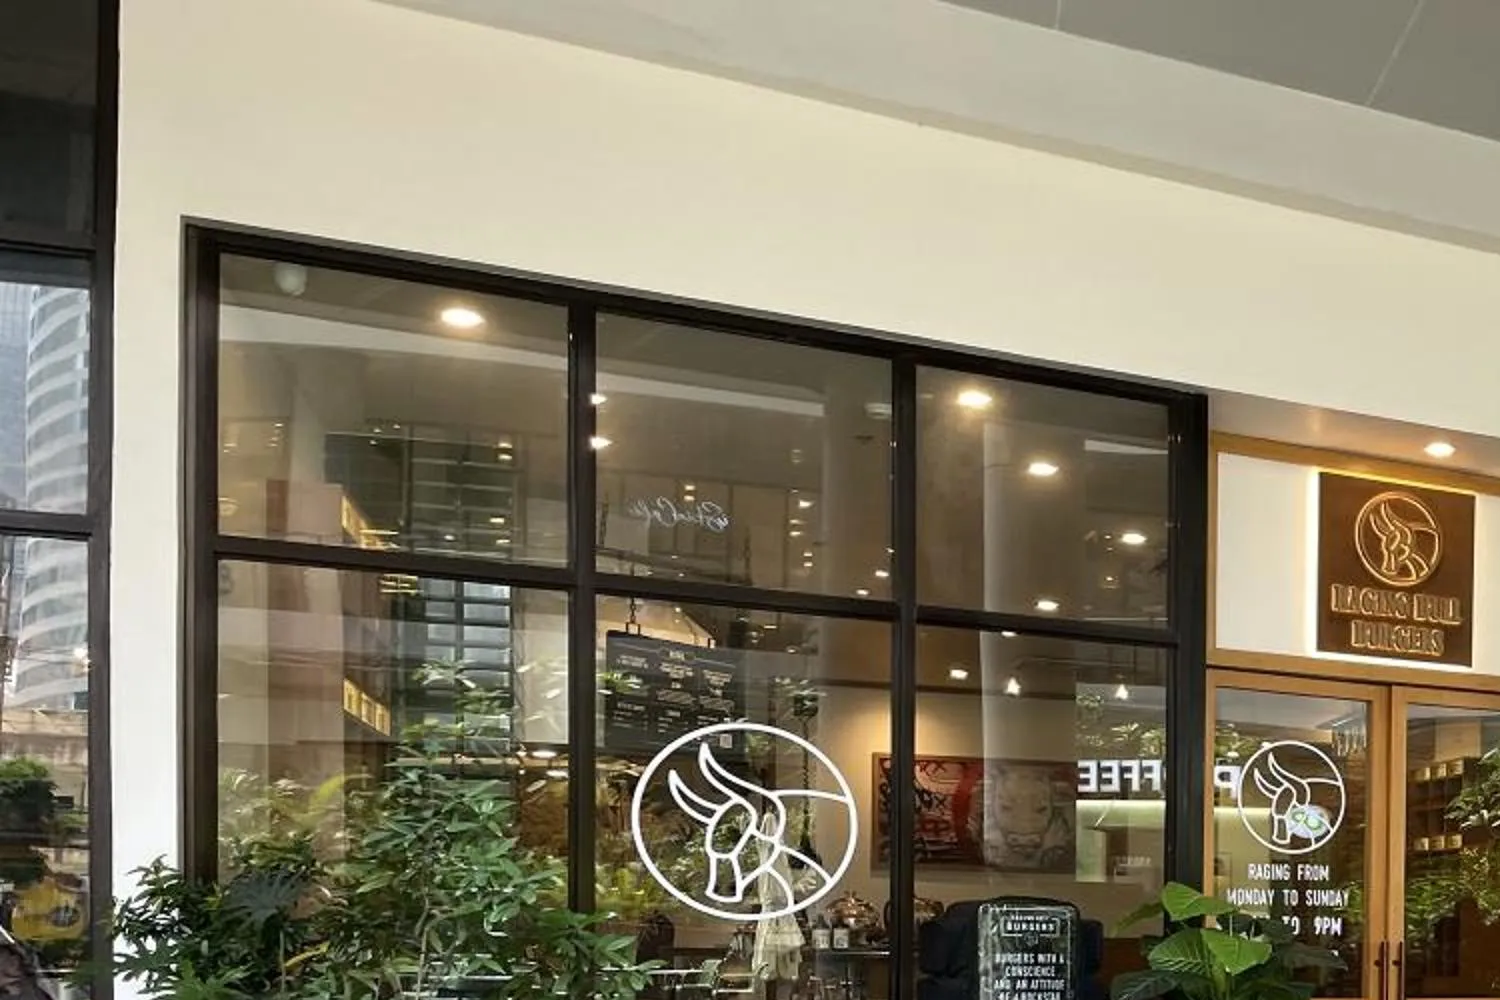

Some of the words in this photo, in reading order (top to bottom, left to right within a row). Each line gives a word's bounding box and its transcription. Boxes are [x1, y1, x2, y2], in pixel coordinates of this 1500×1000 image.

[1331, 583, 1409, 619] RAGING
[1413, 593, 1461, 625] BULL
[1350, 619, 1444, 657] BURGERS
[1247, 863, 1291, 881] RAGING
[1297, 863, 1330, 881] FROM
[1226, 887, 1275, 907] MONDAY
[1281, 889, 1299, 907] TO
[1305, 889, 1350, 907] SUNDAY
[1313, 915, 1343, 938] 9PM
[995, 953, 1035, 964] BURGERS
[1037, 953, 1057, 964] WITH
[1005, 966, 1056, 977] CONSCIENCE
[993, 979, 1011, 990] AND
[1016, 979, 1028, 990] AN
[1030, 979, 1065, 991] ATTITUDE
